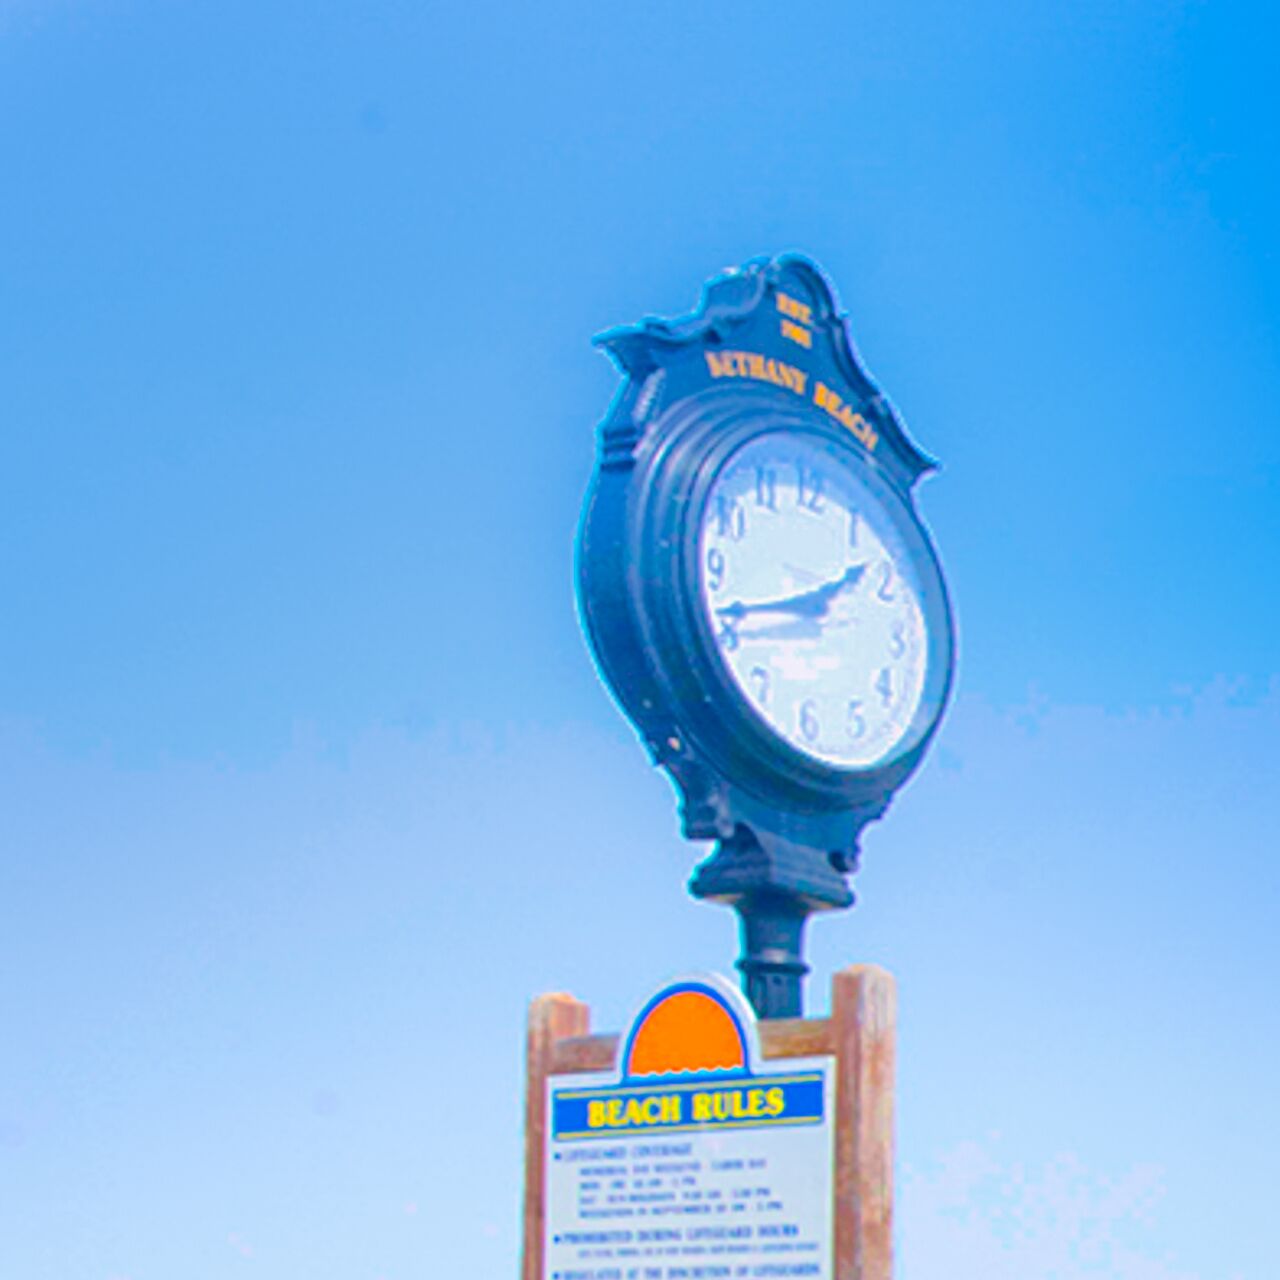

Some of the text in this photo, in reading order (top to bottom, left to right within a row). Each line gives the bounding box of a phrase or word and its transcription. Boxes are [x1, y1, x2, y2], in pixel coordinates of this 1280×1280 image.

[704, 350, 879, 451] BETHANY BEACH
[755, 467, 777, 512] 11
[796, 466, 824, 513] 12
[708, 548, 724, 591] 9
[877, 561, 894, 601] 2
[800, 700, 819, 740] 6
[848, 701, 865, 738] 5
[587, 1087, 786, 1128] BEACH RULES
